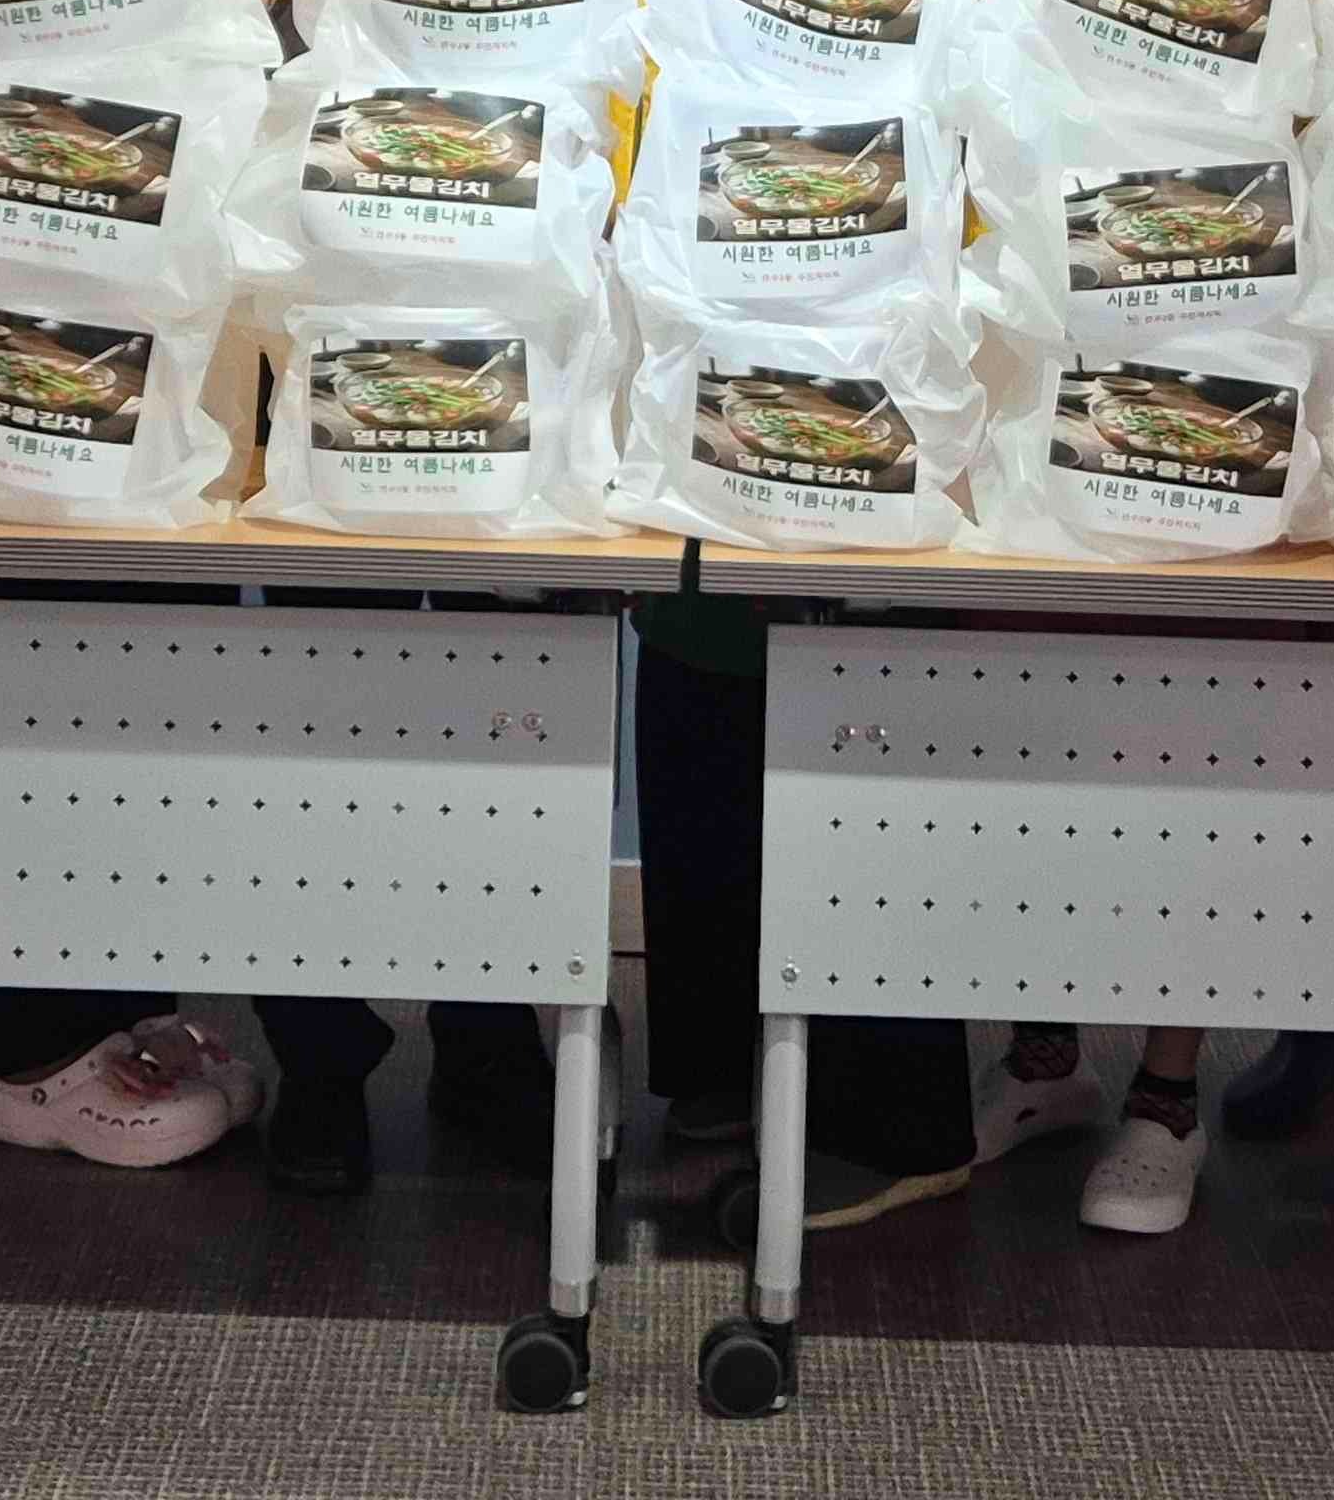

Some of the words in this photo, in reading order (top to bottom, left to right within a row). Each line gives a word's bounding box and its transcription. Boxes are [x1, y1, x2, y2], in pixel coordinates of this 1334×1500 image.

[403, 9, 454, 31] 시원한
[466, 10, 550, 33] 여름나세요
[744, 11, 789, 41] 시원한
[799, 33, 882, 61] 여름나세요
[1075, 13, 1127, 46] 시원한
[1138, 38, 1220, 76] 여름나세요
[339, 199, 392, 219] 시원한
[404, 205, 494, 227] 여름나세요
[722, 245, 774, 263] 시원한
[786, 240, 874, 262] 여름나세요
[1107, 288, 1159, 308] 시원한
[1171, 282, 1259, 304] 여름나세요
[340, 456, 392, 473] 시원한
[404, 457, 495, 474] 여름나세요
[723, 475, 772, 503] 시원한
[785, 489, 875, 513] 여름나세요
[1084, 478, 1139, 501] 시원한
[1150, 488, 1241, 515] 여름나세요
